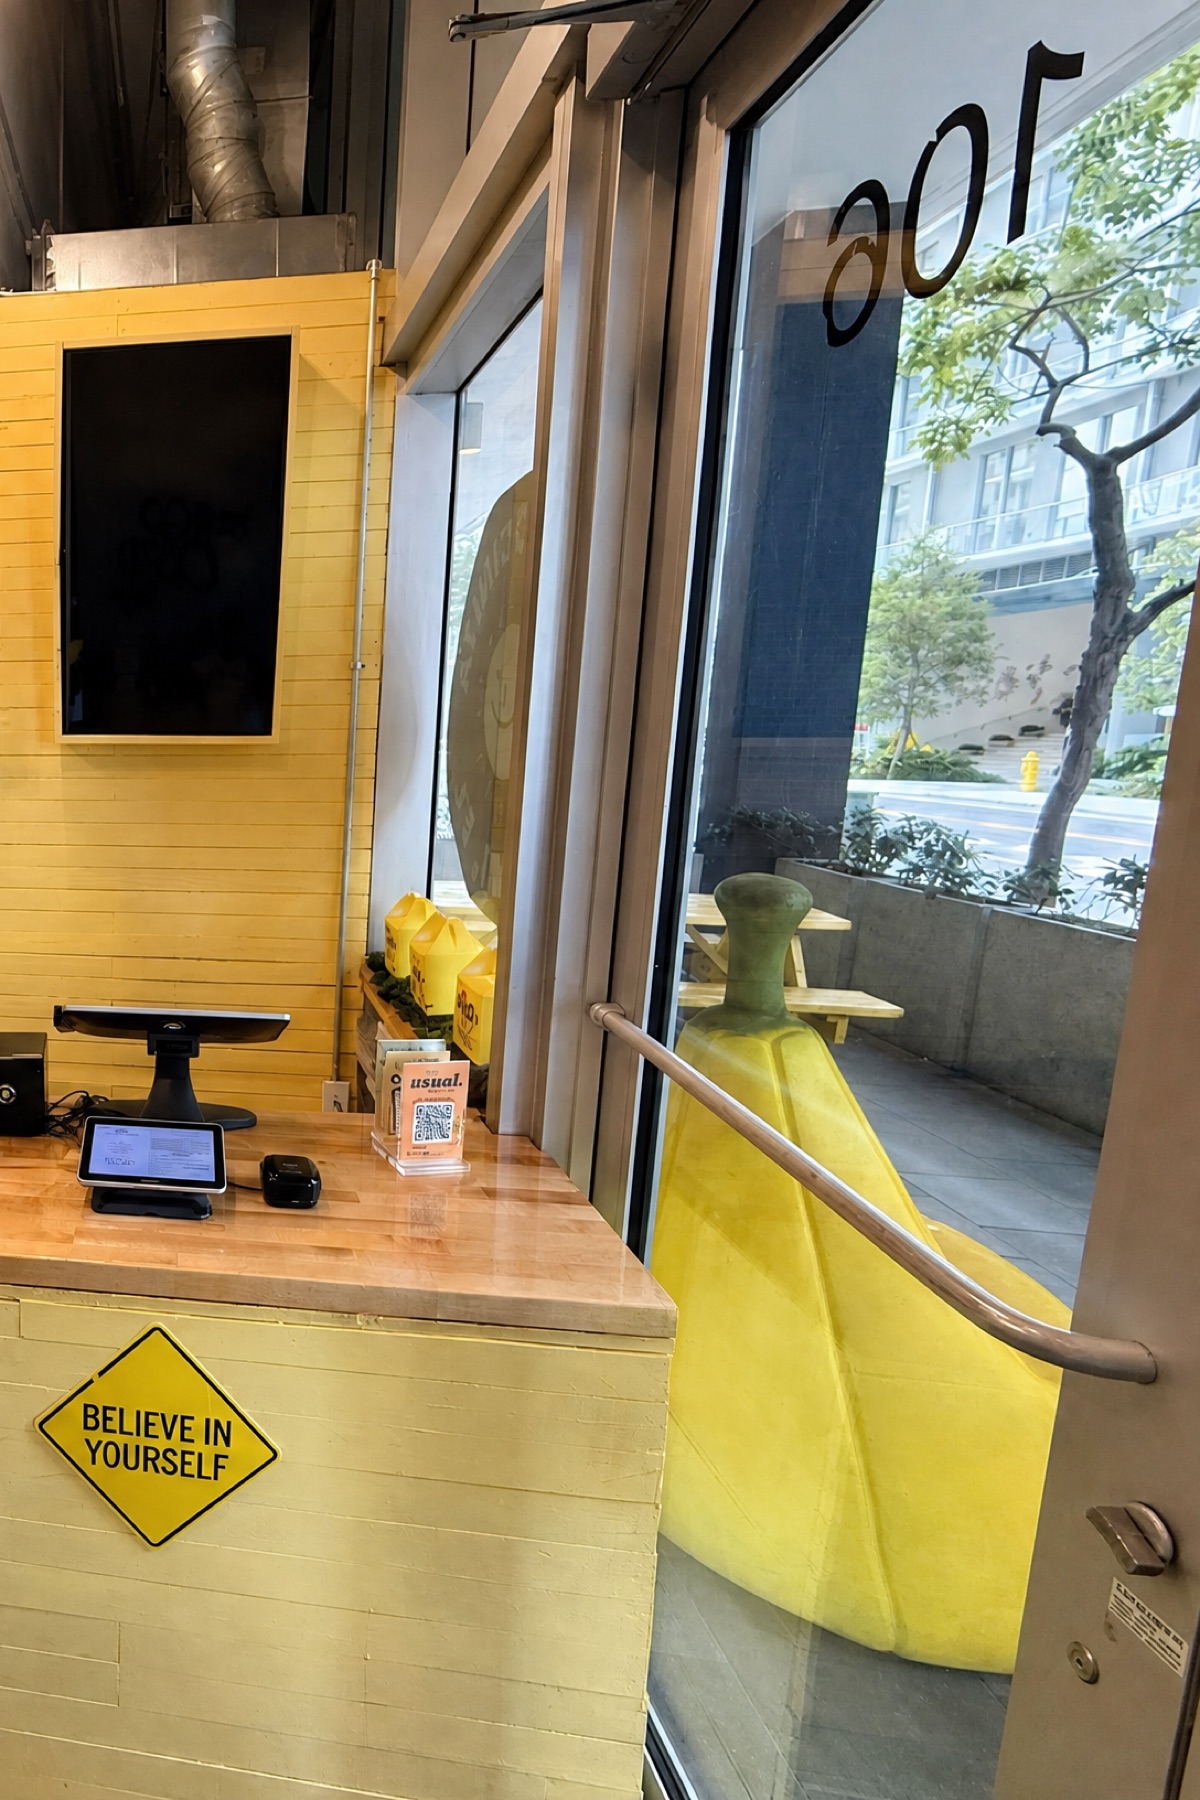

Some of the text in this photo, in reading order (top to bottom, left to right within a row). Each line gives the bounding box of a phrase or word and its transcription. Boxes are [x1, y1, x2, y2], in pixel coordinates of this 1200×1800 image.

[411, 1073, 462, 1088] usual.
[83, 1404, 232, 1447] BELIEVE IN
[85, 1439, 229, 1480] YOURSELF
